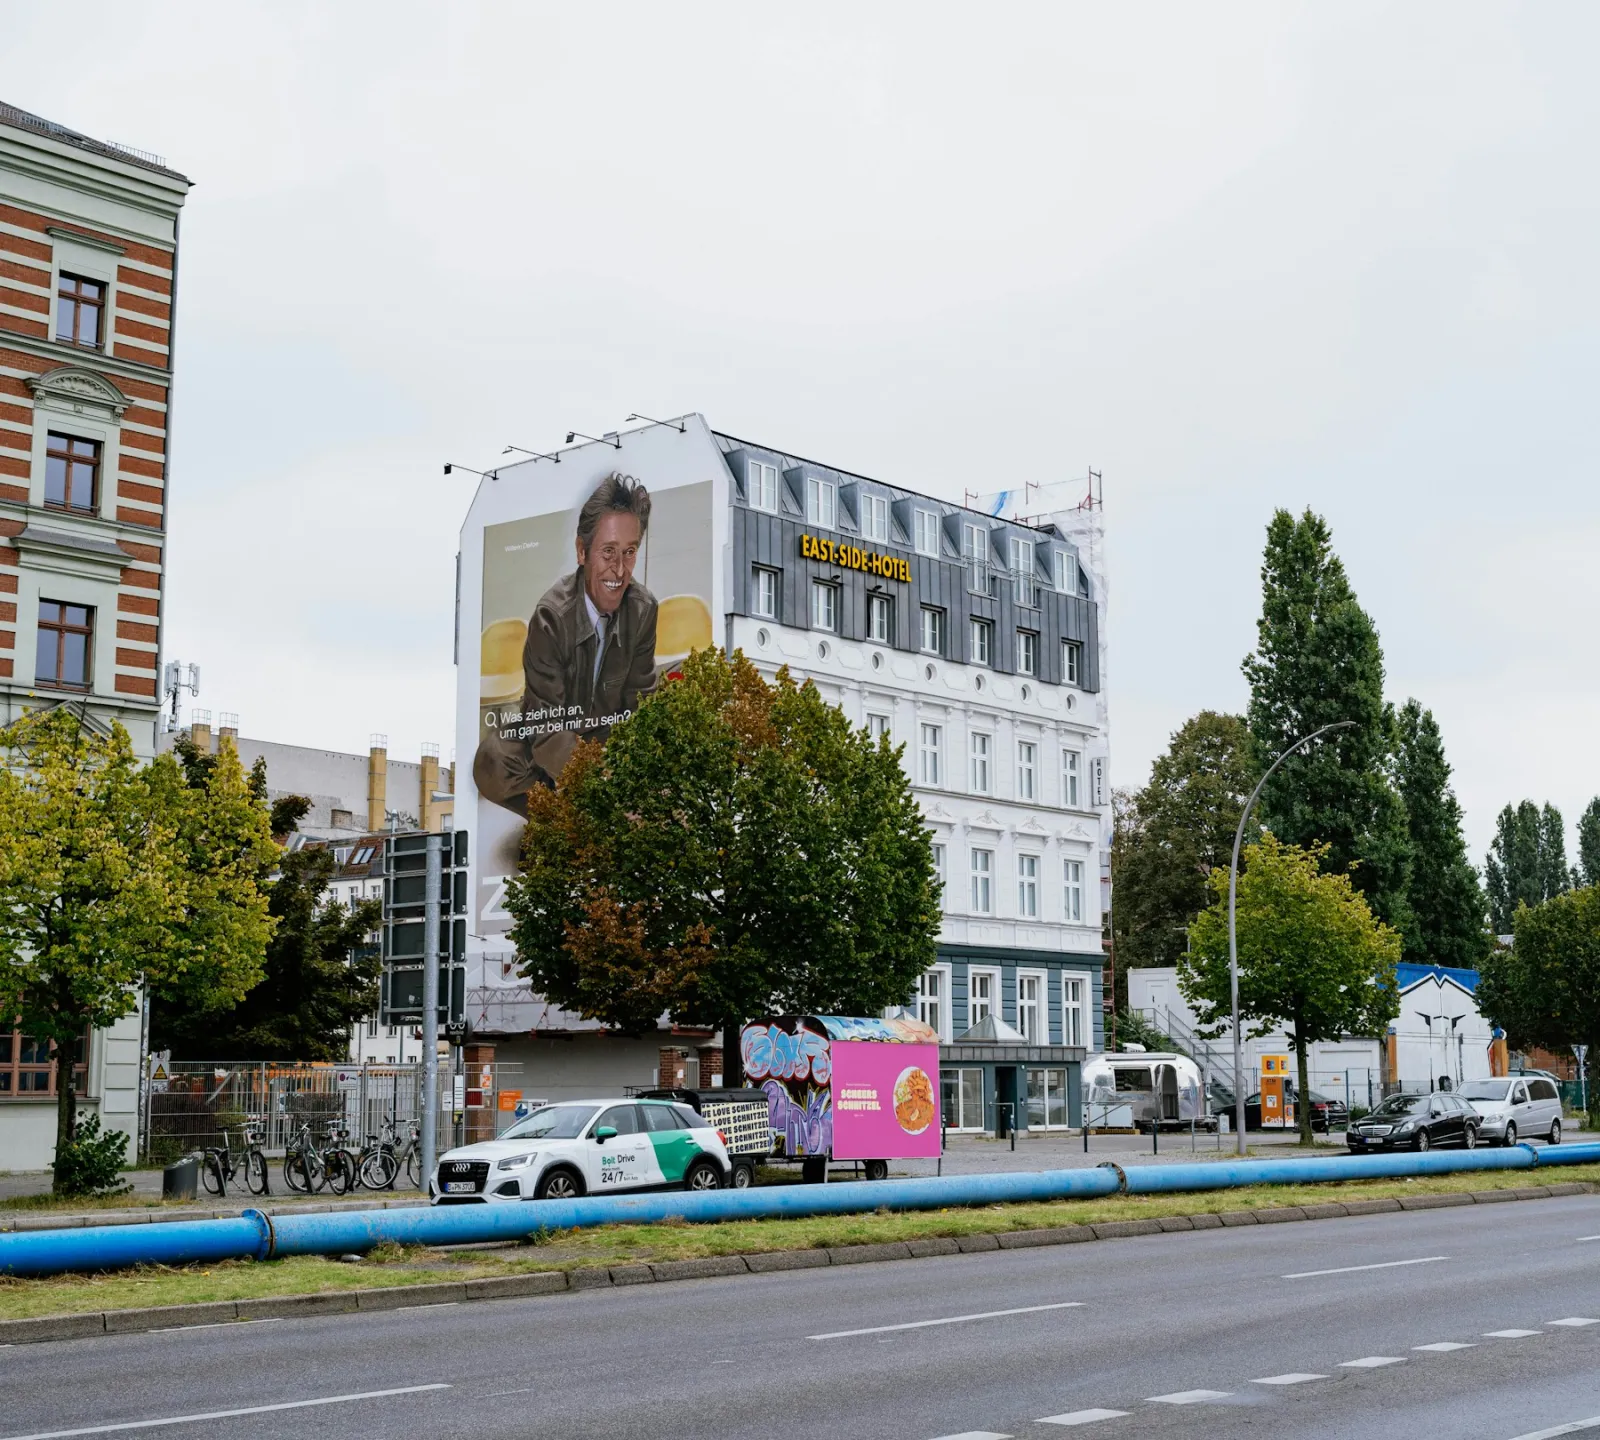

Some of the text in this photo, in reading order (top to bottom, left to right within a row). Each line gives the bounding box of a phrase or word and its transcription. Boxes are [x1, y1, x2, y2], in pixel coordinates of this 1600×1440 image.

[801, 534, 913, 583] EAST-SIDE-HOTEL
[500, 704, 584, 724] Was zieh ich an,
[500, 709, 631, 740] um ganz bei mir zu sein?
[713, 1106, 730, 1117] LOVE
[731, 1102, 768, 1114] SCHNITZEL
[714, 1116, 731, 1127] LOVE
[732, 1111, 769, 1124] SCHNITZEL
[733, 1120, 769, 1133] SCHNITZEL
[735, 1140, 768, 1153] SCHNITZE
[602, 1154, 635, 1166] Bolt Drive
[601, 1171, 623, 1183] 24/7
